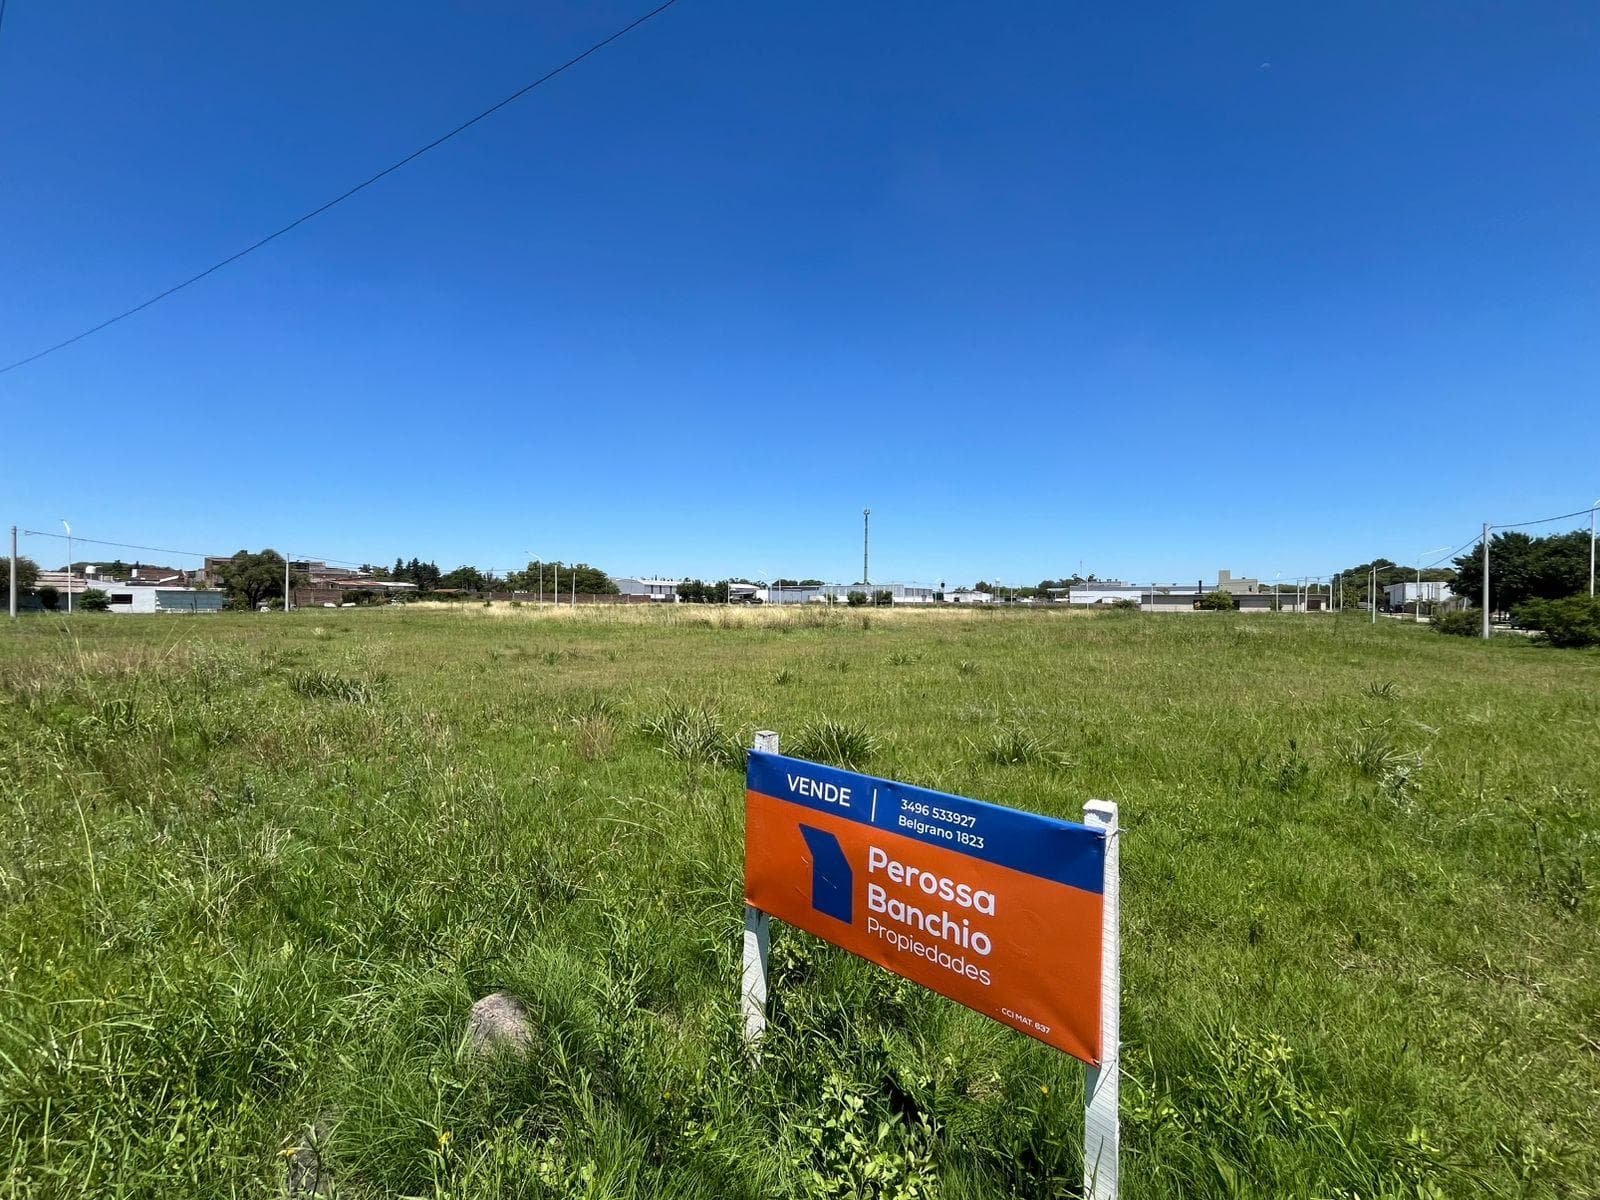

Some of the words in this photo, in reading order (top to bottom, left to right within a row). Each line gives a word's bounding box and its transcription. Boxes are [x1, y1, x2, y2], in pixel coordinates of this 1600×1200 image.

[787, 773, 851, 807] VENDE
[901, 799, 930, 816] 3496
[932, 808, 976, 828] 533927
[899, 815, 953, 839] Belgrano
[956, 830, 984, 849] 1823
[868, 845, 996, 917] Perossa
[868, 883, 992, 956] Banchio
[867, 917, 991, 986] Propiedades
